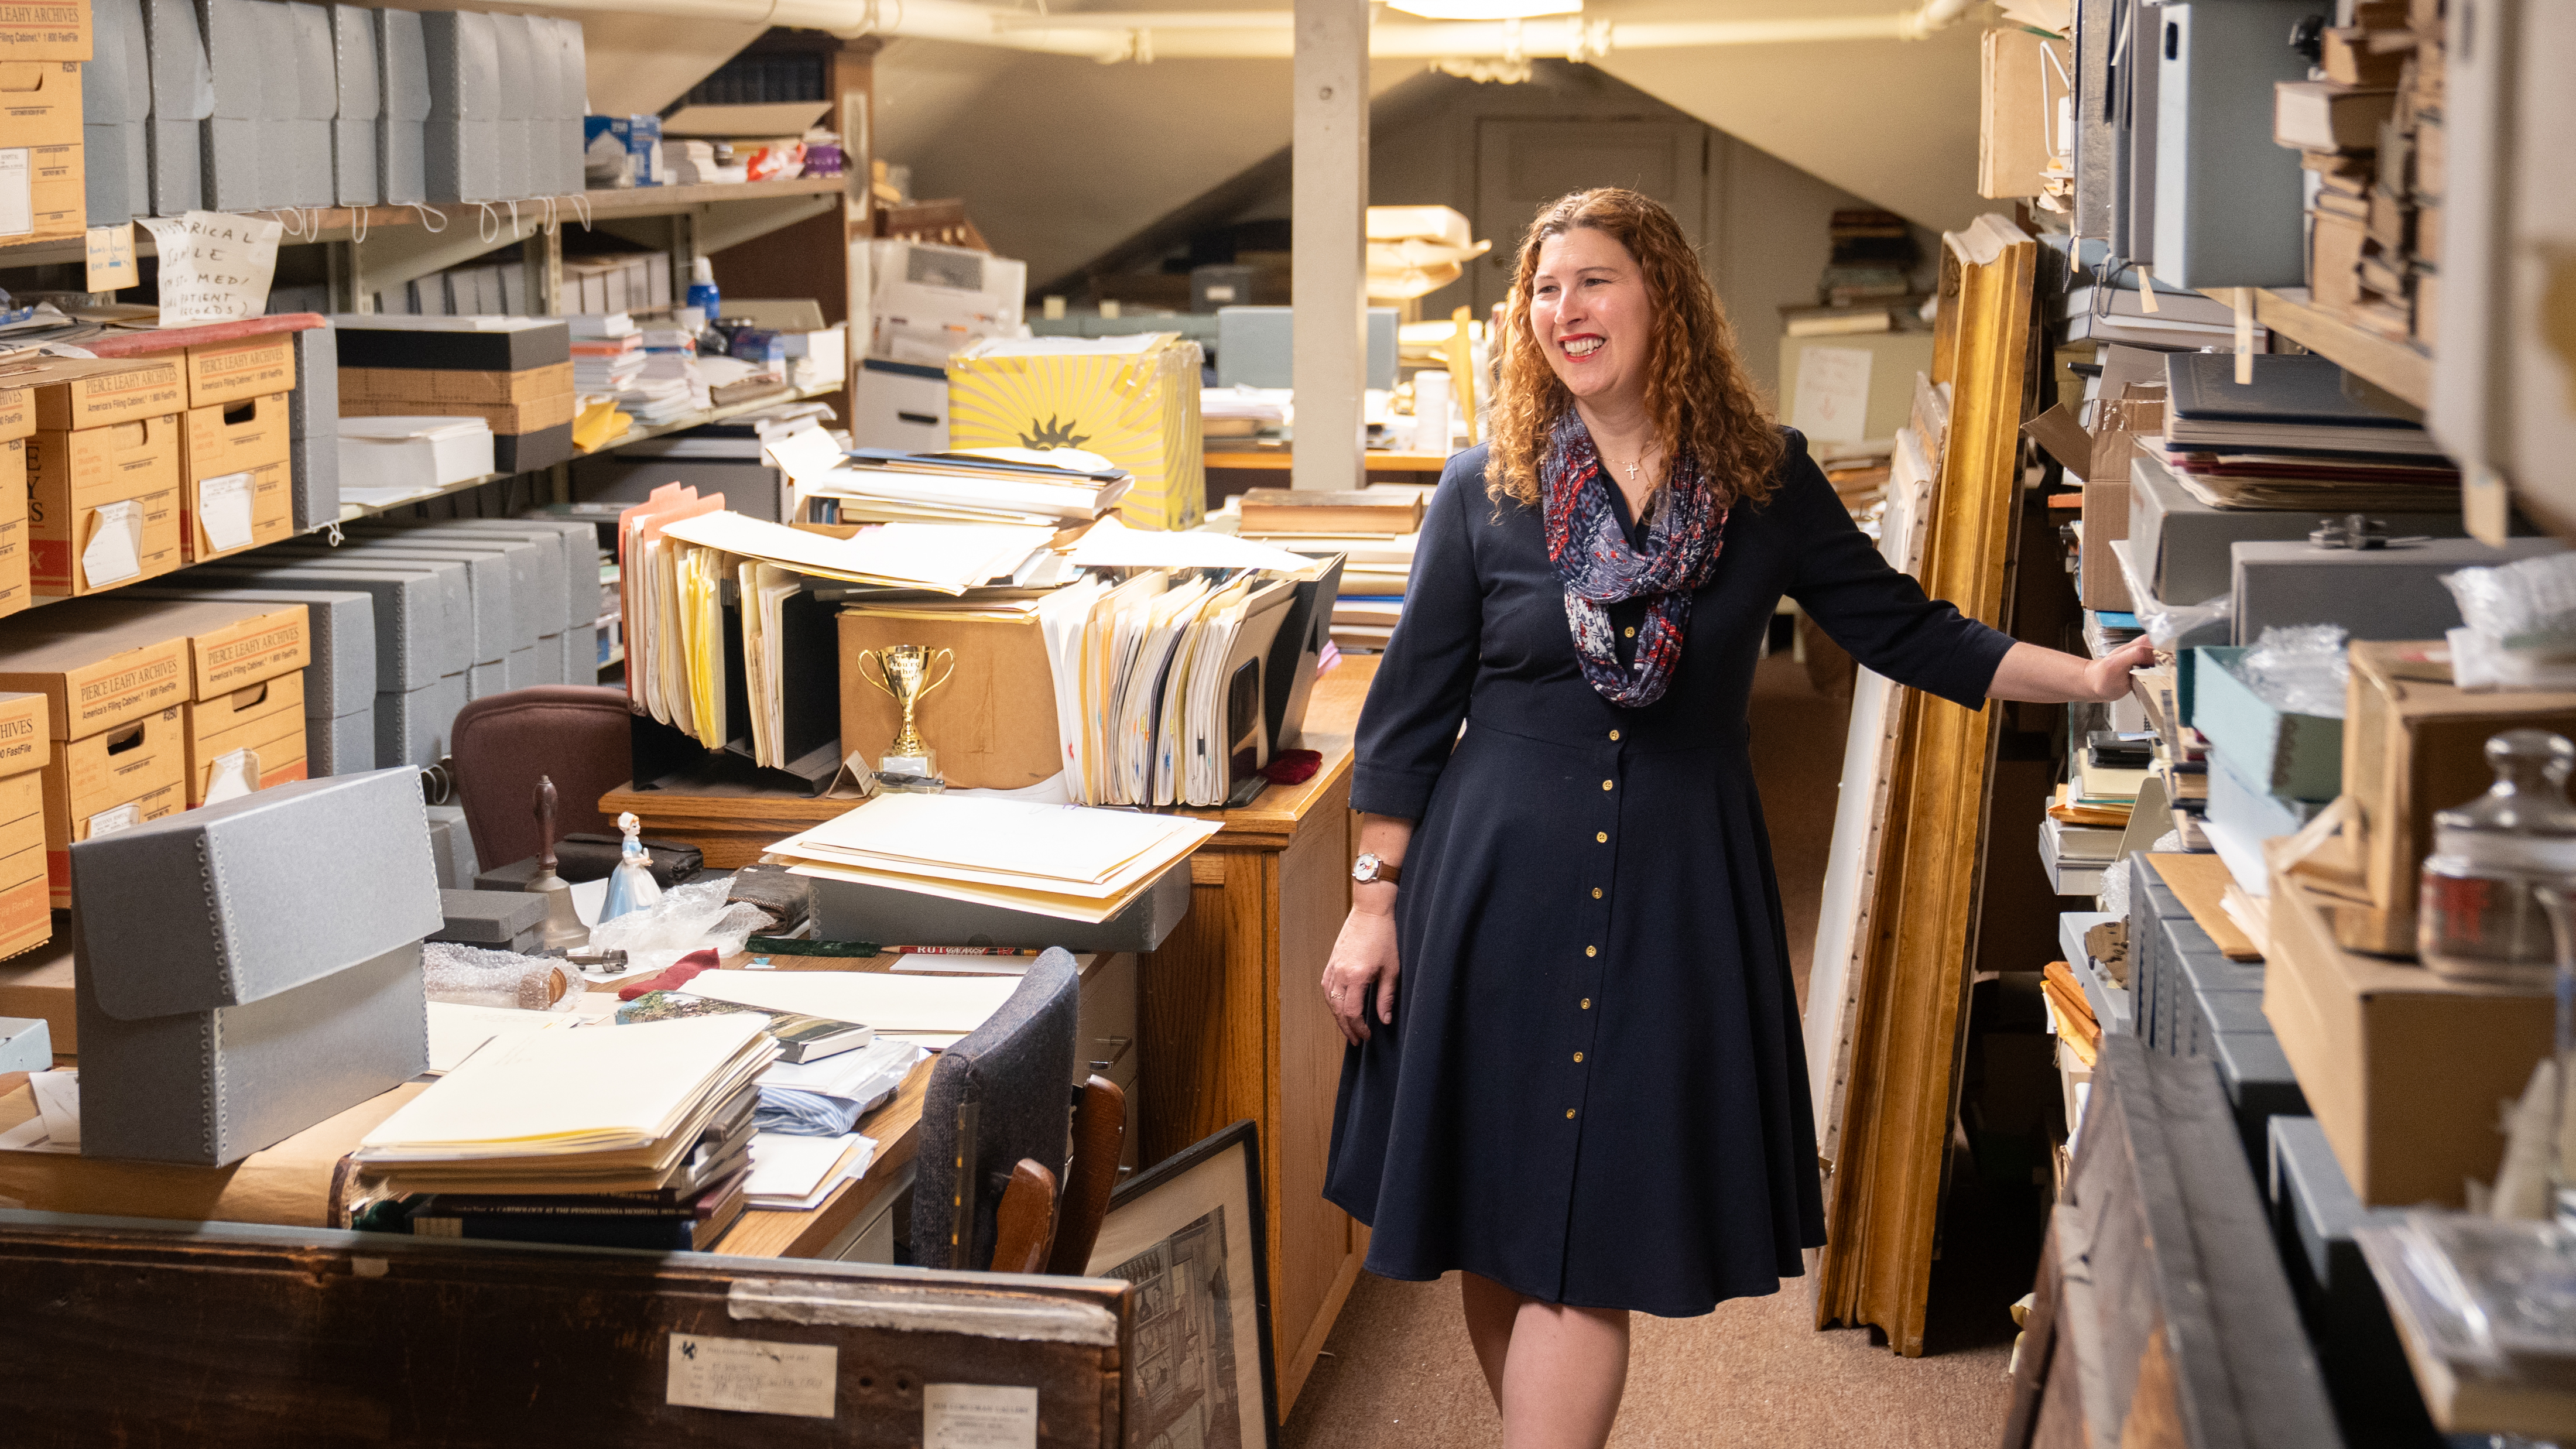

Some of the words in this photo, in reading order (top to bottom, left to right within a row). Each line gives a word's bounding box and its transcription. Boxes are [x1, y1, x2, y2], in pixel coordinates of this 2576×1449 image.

[0, 6, 32, 22] LEAHY
[35, 7, 79, 22] ARCHIVES
[48, 33, 57, 42] 800
[59, 32, 78, 42] FastFile
[225, 354, 249, 369] LEAHY
[250, 347, 284, 365] ARCHIVES
[86, 376, 112, 393] PIERCE
[114, 373, 141, 390] LEAHY
[142, 368, 177, 385] ARCHIVES
[88, 402, 112, 412] America's
[113, 399, 126, 409] Filing
[161, 390, 177, 400] FastFile
[5, 413, 23, 425] FastFile
[208, 646, 234, 666] PIERCE
[235, 638, 261, 657] LEAHY
[263, 627, 299, 649] ARCHIVES
[210, 670, 233, 683] America's
[234, 666, 246, 674] Filing
[282, 648, 298, 659] FastFile
[81, 681, 108, 702] PIERCE
[110, 672, 137, 693] LEAHY
[138, 659, 177, 684] ARCHIVES
[83, 705, 107, 720] America's
[108, 701, 122, 711] Filing
[149, 687, 159, 697] 800
[159, 681, 176, 695] FastFile
[6, 744, 32, 758] FastFile
[917, 946, 984, 955] RUTGERS
